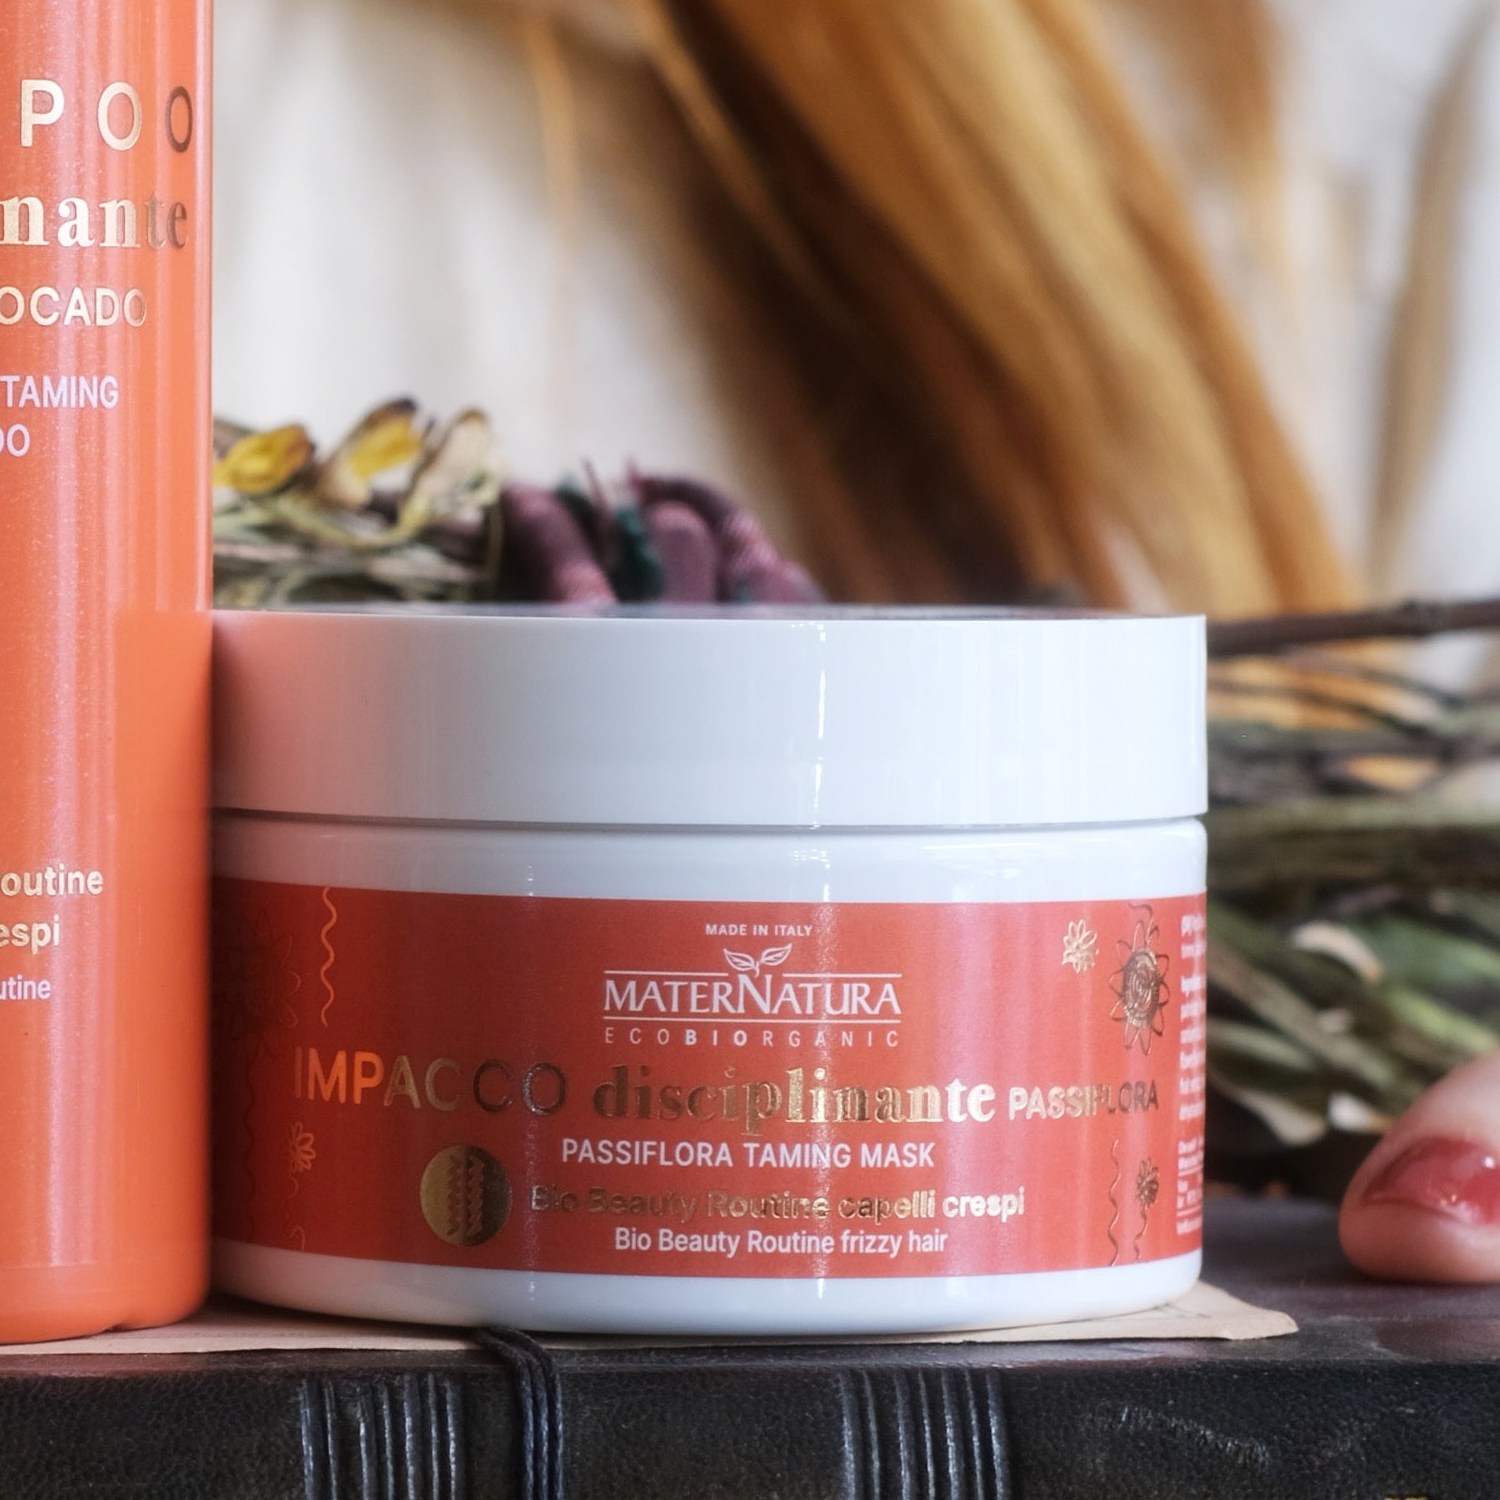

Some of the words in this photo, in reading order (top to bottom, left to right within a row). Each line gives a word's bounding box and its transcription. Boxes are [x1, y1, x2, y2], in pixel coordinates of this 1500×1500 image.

[0, 375, 120, 409] TAMING
[705, 923, 747, 936] MADE
[753, 924, 769, 936] IN
[774, 924, 813, 937] ITALY
[295, 1046, 567, 1116] IMPACCO
[592, 1064, 996, 1136] disciplinante
[1008, 1079, 1159, 1120] PASSIFLORA
[562, 1138, 733, 1167] PASSIFLORA
[744, 1143, 851, 1168] TAMING
[861, 1143, 935, 1168] MASK
[531, 1184, 577, 1213] Bio
[587, 1187, 697, 1223] Beauty
[707, 1190, 830, 1218] Routine
[838, 1190, 935, 1227] capelli
[943, 1187, 1025, 1226] crespi
[614, 1227, 651, 1251] Bio
[658, 1228, 739, 1258] Beauty
[748, 1230, 835, 1253] Routine
[841, 1230, 902, 1259] frizzy
[908, 1229, 948, 1253] hair
